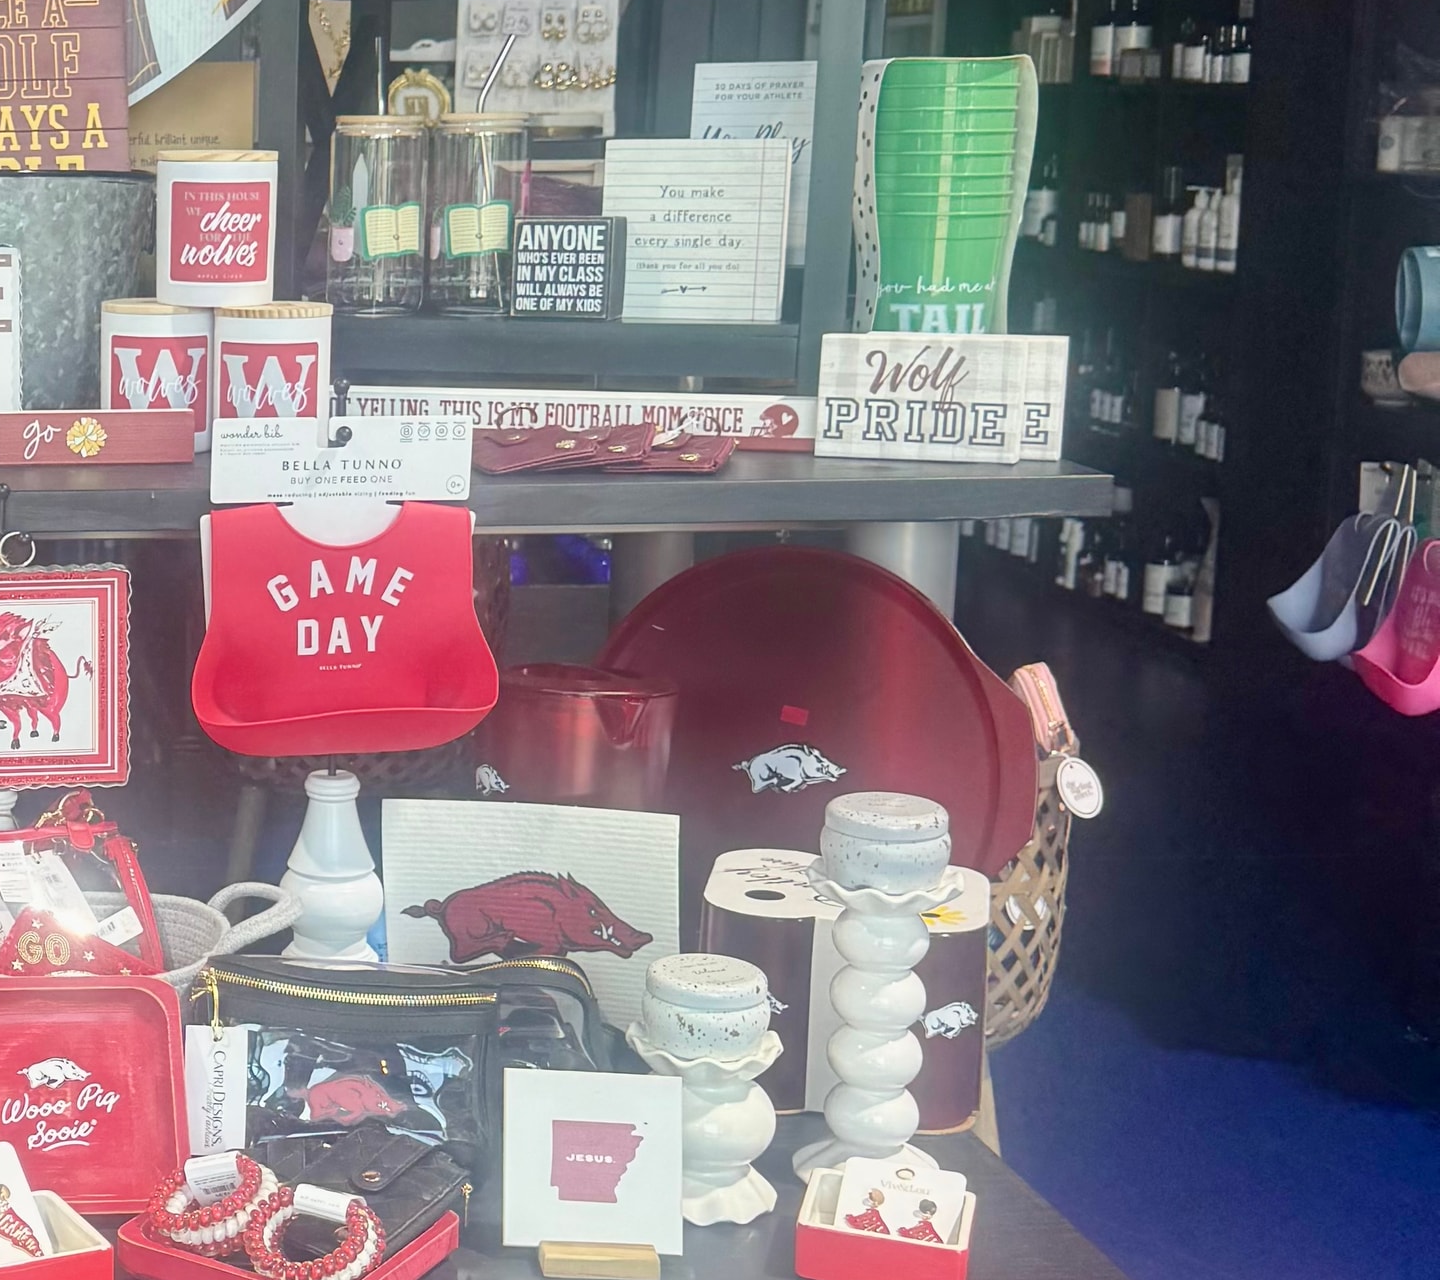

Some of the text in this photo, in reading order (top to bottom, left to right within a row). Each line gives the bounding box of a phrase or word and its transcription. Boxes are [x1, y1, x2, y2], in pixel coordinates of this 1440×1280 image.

[763, 92, 803, 100] ATHLETE
[769, 81, 804, 90] PRAYER
[82, 102, 109, 150] A
[184, 191, 196, 201] IN
[198, 191, 225, 202] THIS
[660, 185, 725, 199] You make
[200, 201, 262, 233] cheer
[663, 210, 733, 223] difference
[180, 234, 259, 267] wolves
[518, 224, 606, 251] ANYONE
[634, 234, 712, 250] every single
[516, 265, 605, 283] IN MY CLASS
[517, 252, 605, 265] WHO'S EVER BEEN
[516, 283, 604, 297] WILL ALWAYS BE
[916, 276, 982, 295] had me
[515, 297, 603, 313] ONE OF MY KIDS
[889, 303, 987, 334] TAIL
[113, 347, 206, 411] W
[119, 373, 203, 404] wolves
[222, 354, 317, 418] W
[865, 345, 970, 414] Wolf
[227, 381, 311, 413] wolves
[439, 400, 482, 426] THIS
[823, 397, 1009, 448] PRIDE
[21, 418, 62, 461] go
[220, 424, 284, 439] wonder bib
[282, 459, 403, 471] BELLA TUNNO
[290, 475, 393, 485] BUY ONE FEED ONE
[266, 556, 414, 613] GAME
[297, 615, 384, 656] DAY
[18, 930, 71, 966] GO
[212, 1050, 227, 1089] CAPRI
[2, 1083, 121, 1125] Wooo Pig
[27, 1119, 93, 1150] Sooie
